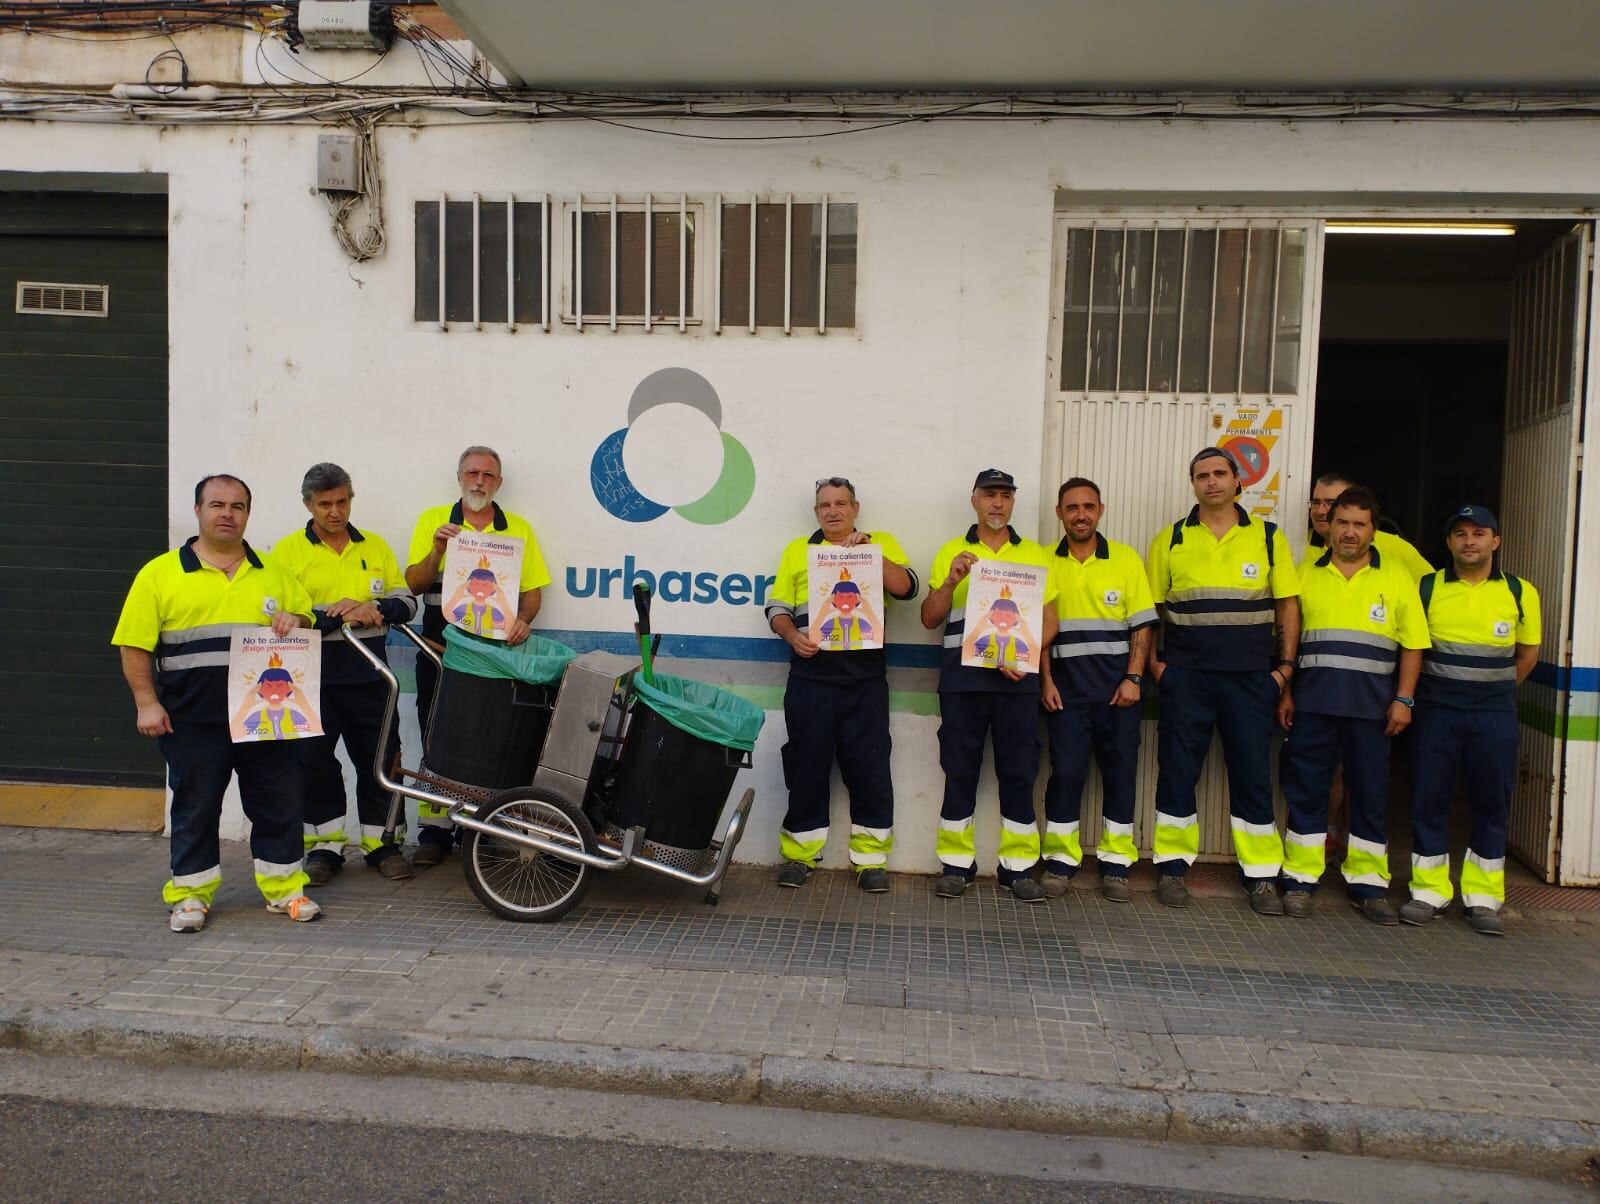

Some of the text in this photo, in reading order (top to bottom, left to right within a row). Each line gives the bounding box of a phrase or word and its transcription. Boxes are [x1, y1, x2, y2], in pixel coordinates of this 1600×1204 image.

[458, 538, 515, 551] No te calientes
[817, 553, 829, 561] No
[981, 567, 1037, 580] No te calientes
[566, 555, 777, 606] urbaser
[242, 636, 310, 645] No te calientes
[246, 727, 269, 736] 2022
